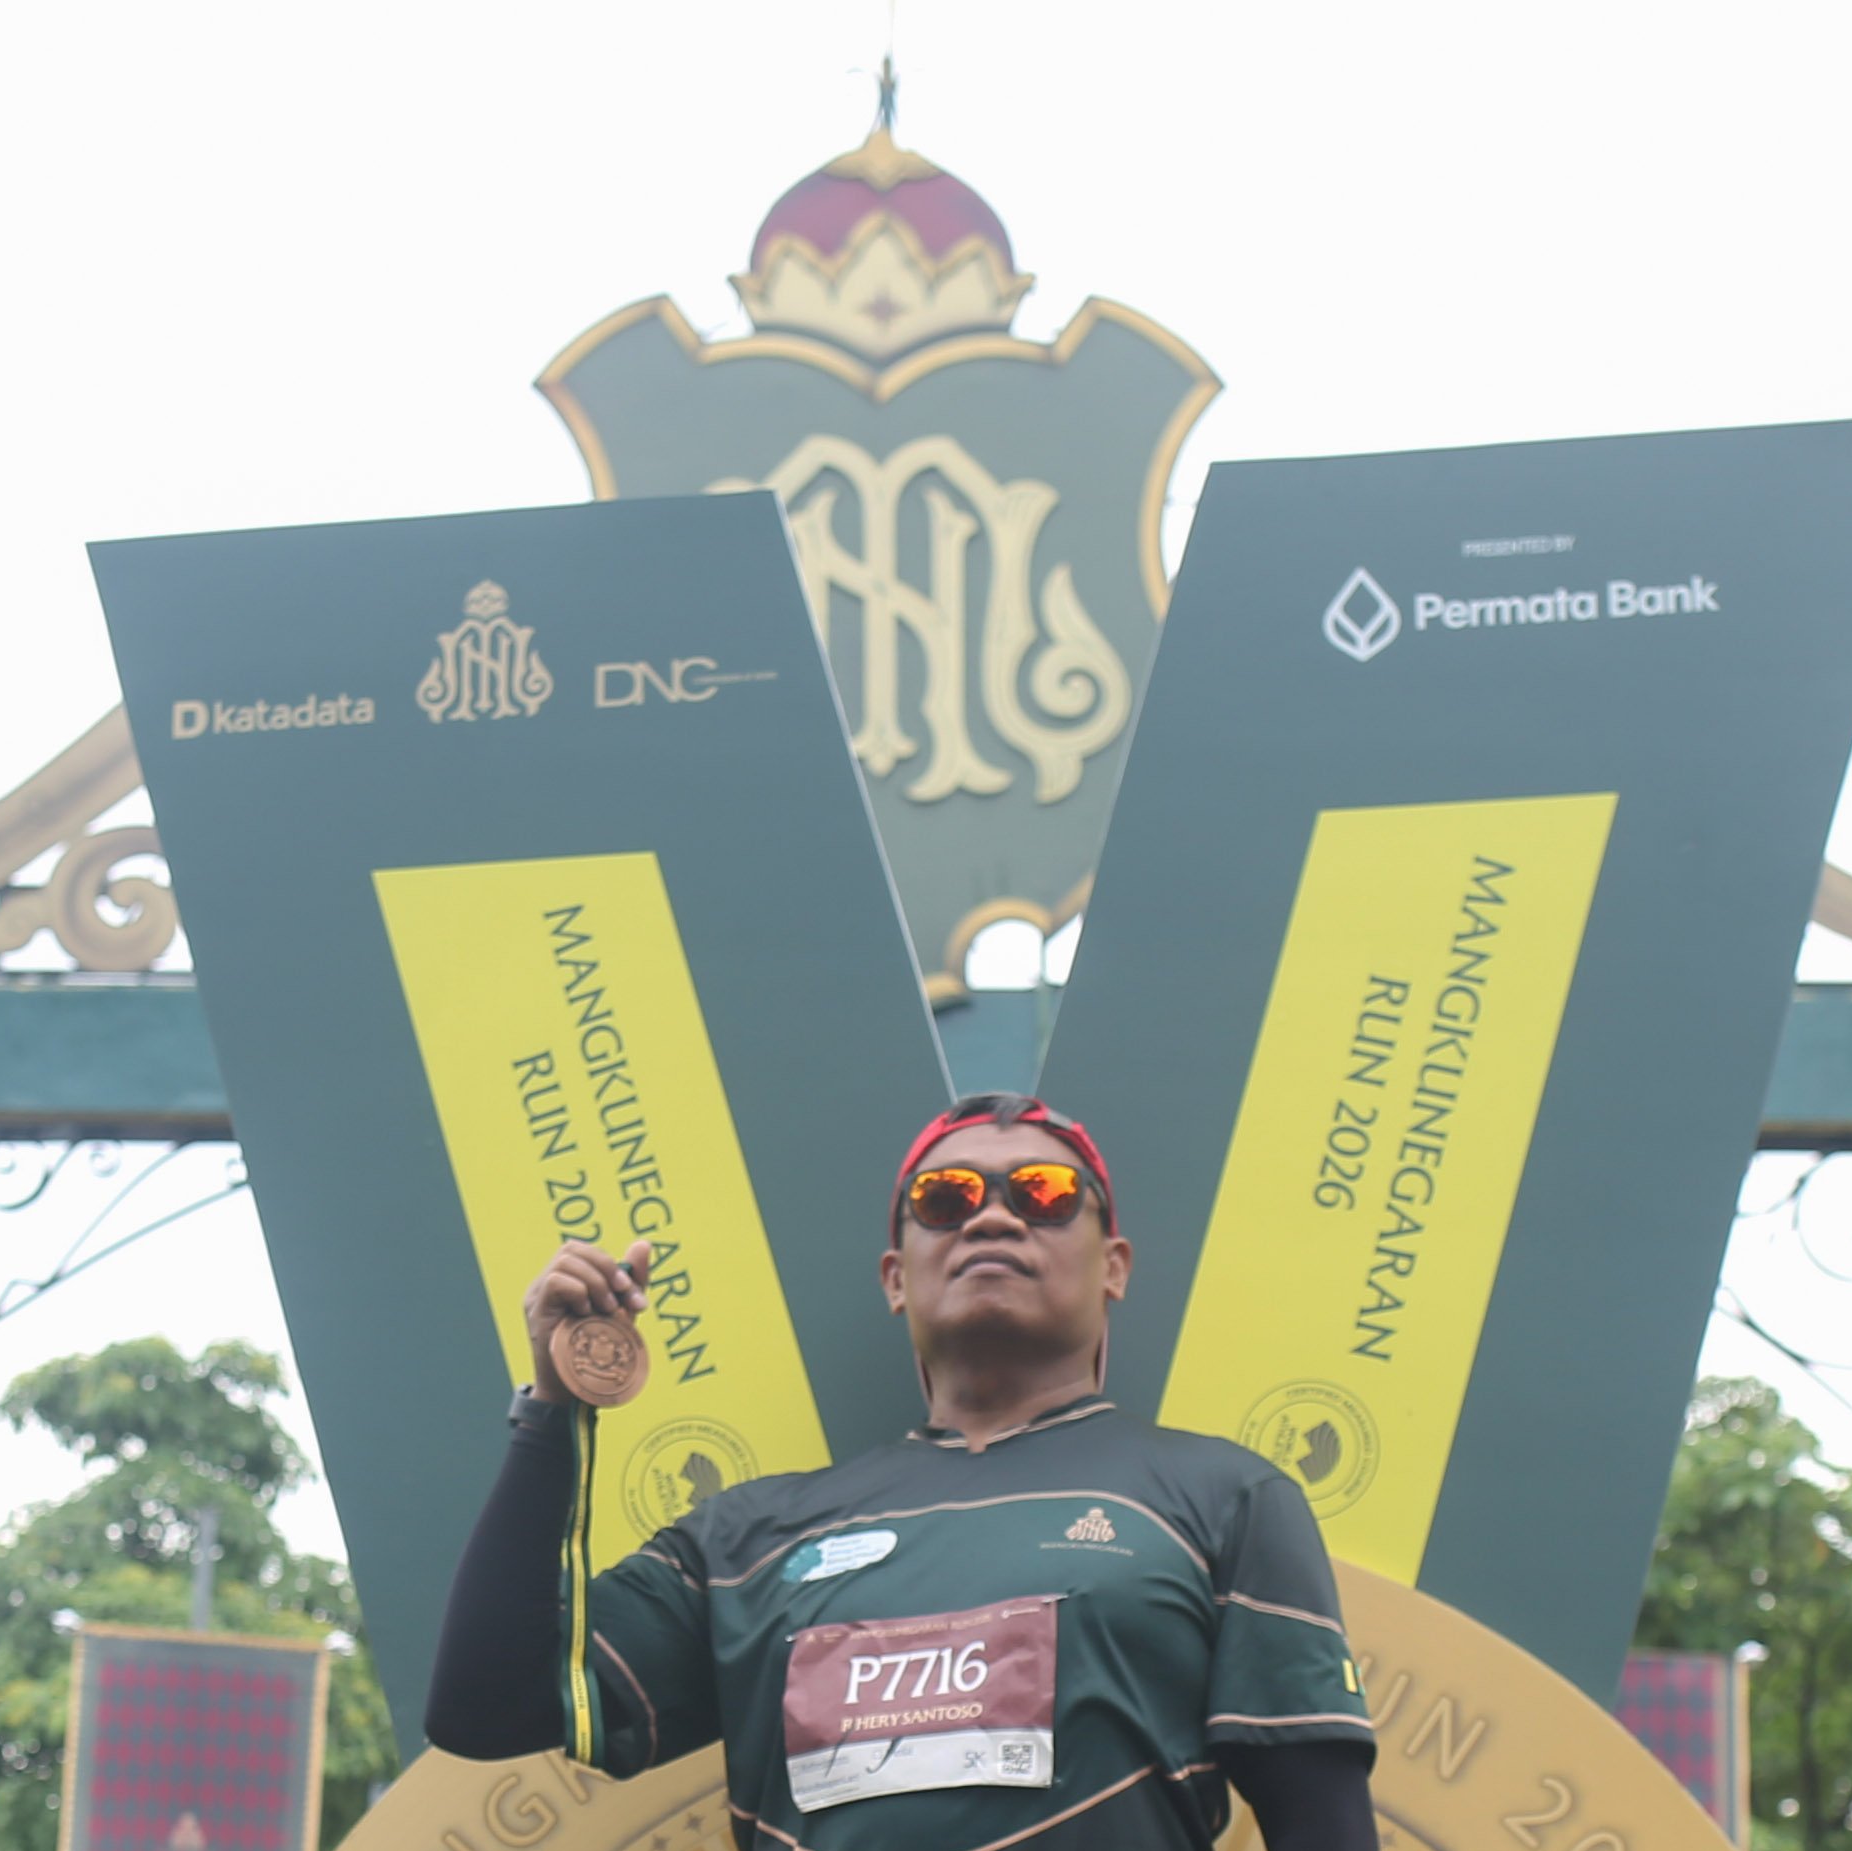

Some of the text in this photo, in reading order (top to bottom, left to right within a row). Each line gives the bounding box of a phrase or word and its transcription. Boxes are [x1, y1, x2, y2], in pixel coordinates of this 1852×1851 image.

[1461, 534, 1577, 558] PRESENTED BY
[1414, 574, 1720, 630] Permata Bank
[594, 655, 719, 709] DNC
[1313, 974, 1411, 1211] RUN 2026
[1349, 855, 1516, 1362] MANGKUNEGARAN
[511, 1049, 602, 1245] RUN 202
[542, 904, 717, 1385] MANGKUNEGARAN
[844, 1640, 988, 1704] P7716
[855, 1712, 900, 1732] HERY
[899, 1702, 984, 1727] SANTOSO
[1355, 1653, 1487, 1780] UN
